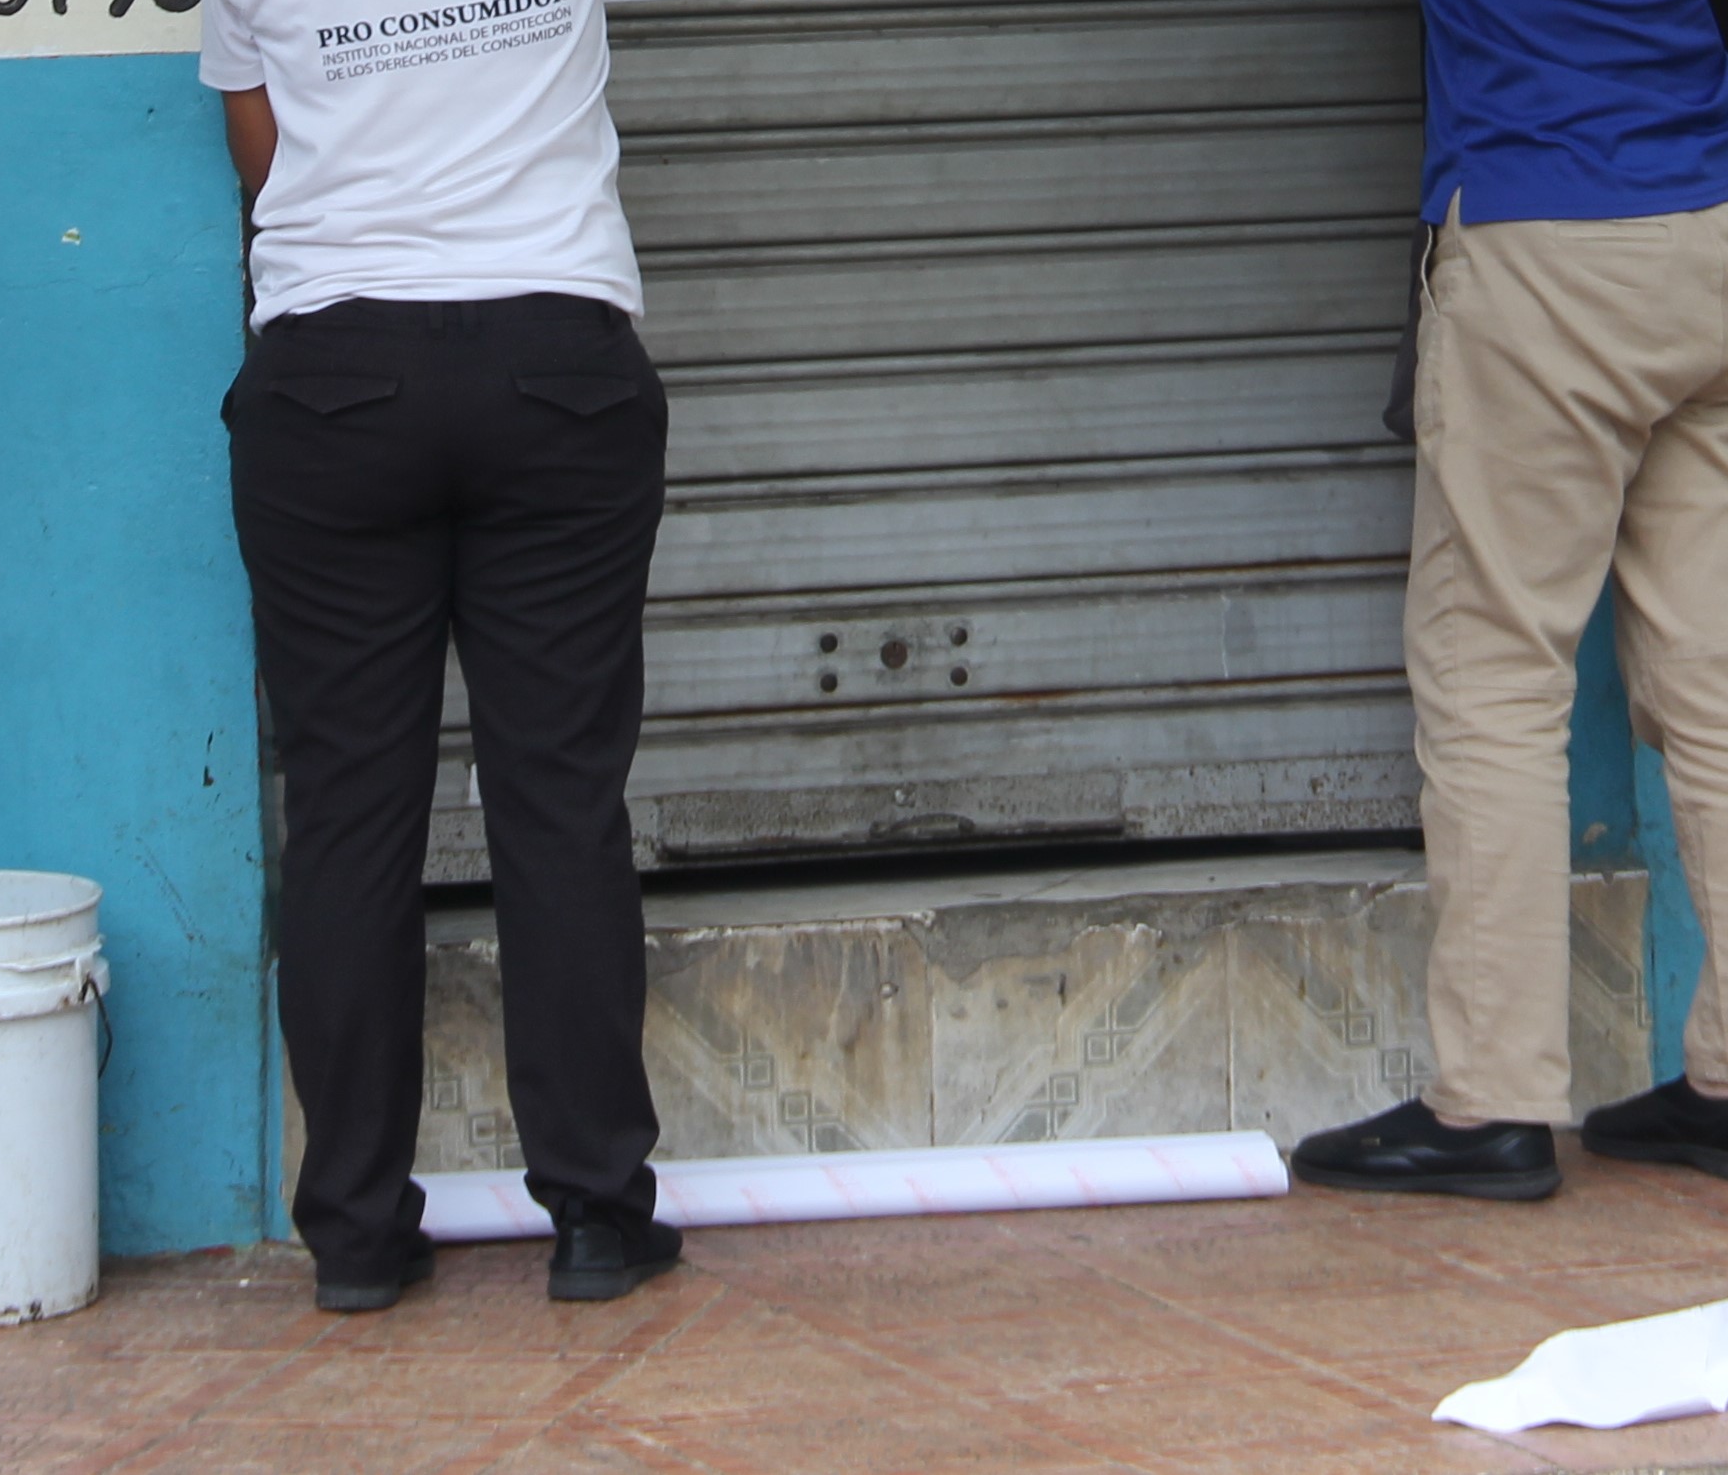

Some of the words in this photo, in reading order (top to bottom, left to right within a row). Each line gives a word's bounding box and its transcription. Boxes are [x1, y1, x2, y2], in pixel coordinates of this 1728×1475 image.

[317, 24, 373, 49] PRO
[322, 43, 392, 67] INSTITUTO
[394, 31, 466, 54] NACIONAL
[469, 25, 490, 41] DE
[492, 5, 572, 36] PROTECCIÓN
[325, 68, 346, 82] DE
[347, 62, 374, 79] LOS
[375, 49, 449, 74] DERECHOS
[452, 44, 479, 60] DEL
[482, 20, 573, 54] CONSUMIDOR
